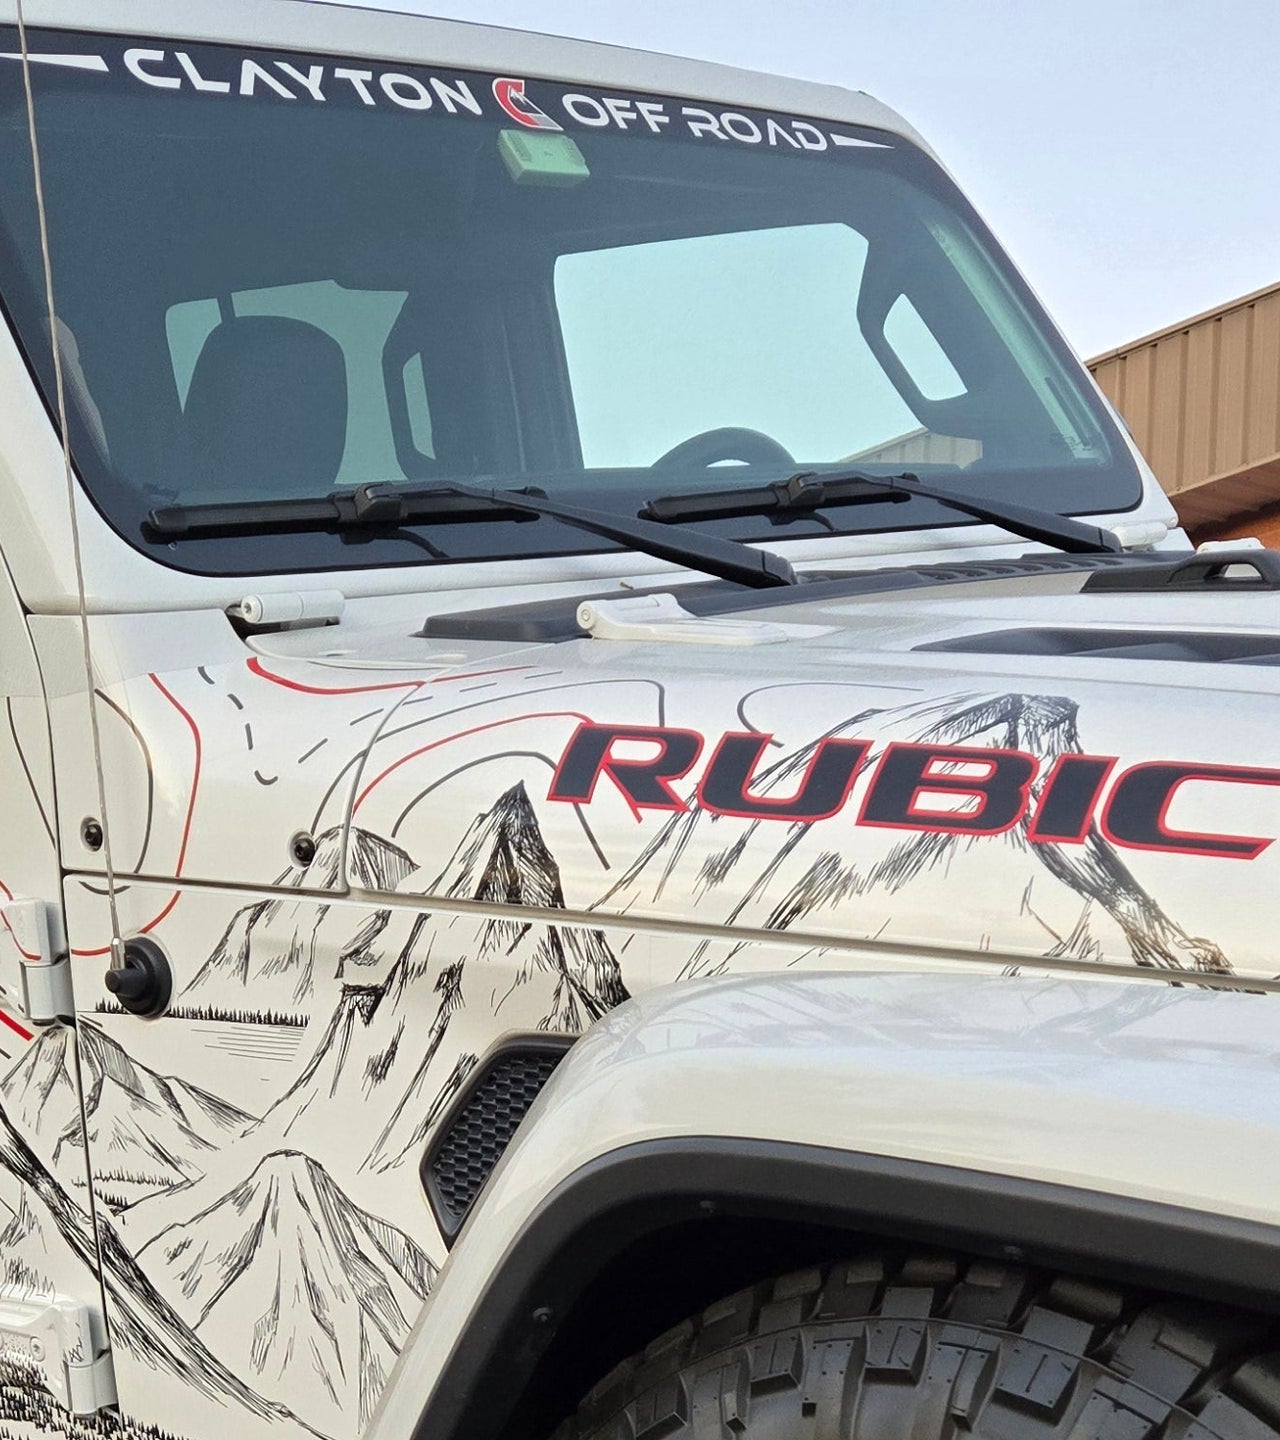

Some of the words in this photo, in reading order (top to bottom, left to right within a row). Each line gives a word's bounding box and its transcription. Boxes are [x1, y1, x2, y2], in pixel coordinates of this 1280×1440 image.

[124, 48, 482, 116] CLAYTON
[562, 93, 671, 134] OFF
[686, 107, 827, 152] ROAD
